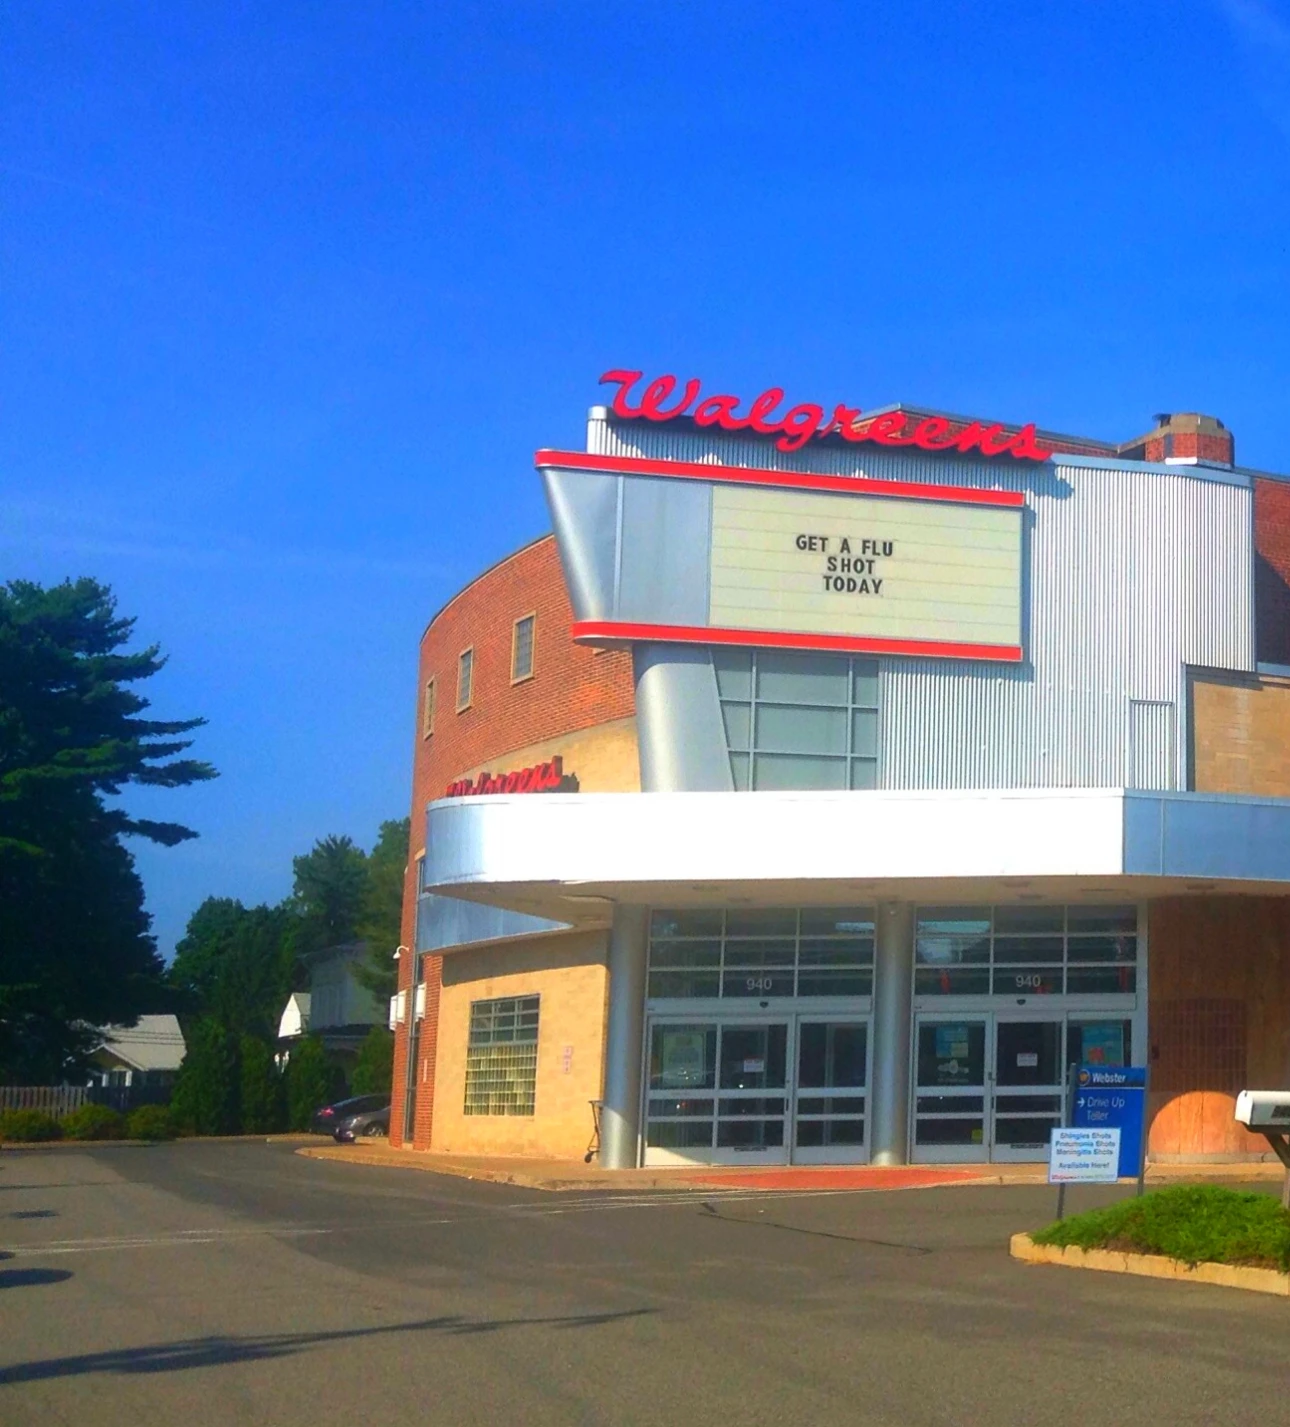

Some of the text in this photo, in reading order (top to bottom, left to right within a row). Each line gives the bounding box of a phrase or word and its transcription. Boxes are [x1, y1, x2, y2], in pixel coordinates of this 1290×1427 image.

[599, 368, 1052, 462] Walgreens
[796, 534, 893, 557] GET A FLU
[827, 556, 876, 575] SHOT
[823, 576, 883, 595] TODAY
[746, 978, 773, 991] 940
[1015, 975, 1042, 988] 940
[1092, 1072, 1127, 1084] Webster
[1087, 1096, 1126, 1109] Drive Up
[1087, 1109, 1109, 1121] Teller
[1059, 1161, 1090, 1169] Available
